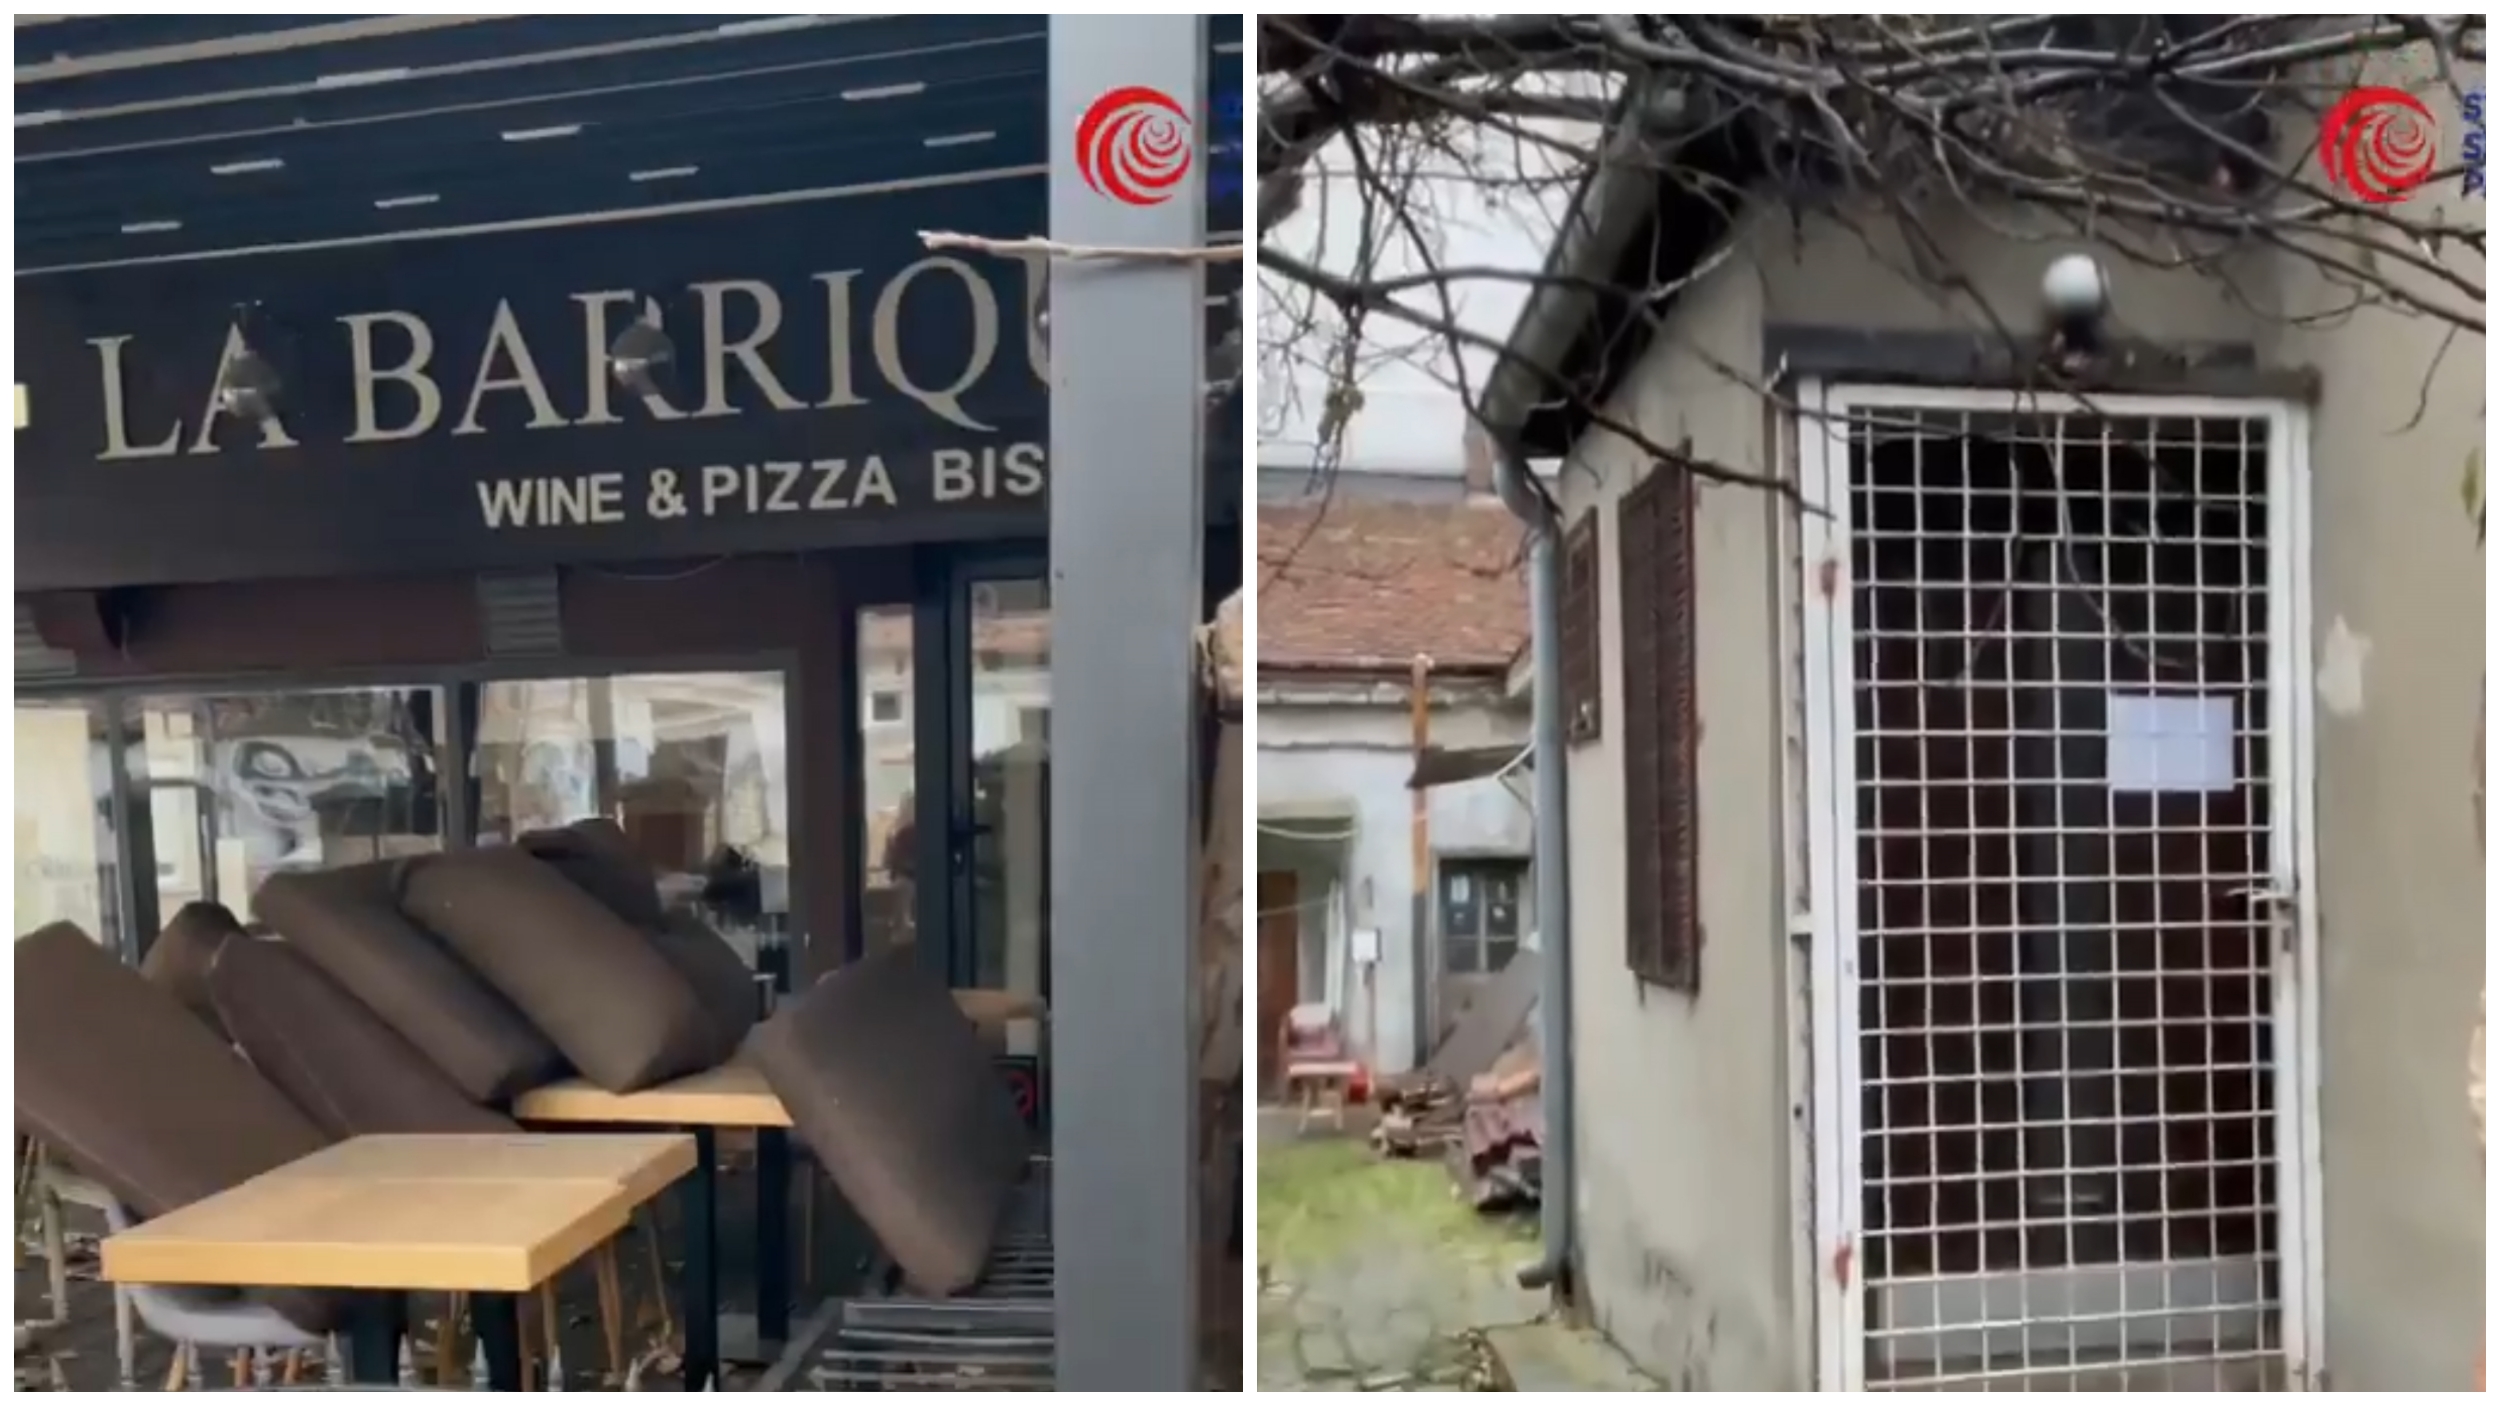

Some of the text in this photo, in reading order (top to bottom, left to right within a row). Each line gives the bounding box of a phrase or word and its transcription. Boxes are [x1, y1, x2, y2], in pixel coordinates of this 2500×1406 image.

[86, 254, 1229, 460] LA BARRIQ
[476, 472, 625, 528] WINE
[647, 467, 687, 518] &
[702, 455, 898, 515] PIZZA
